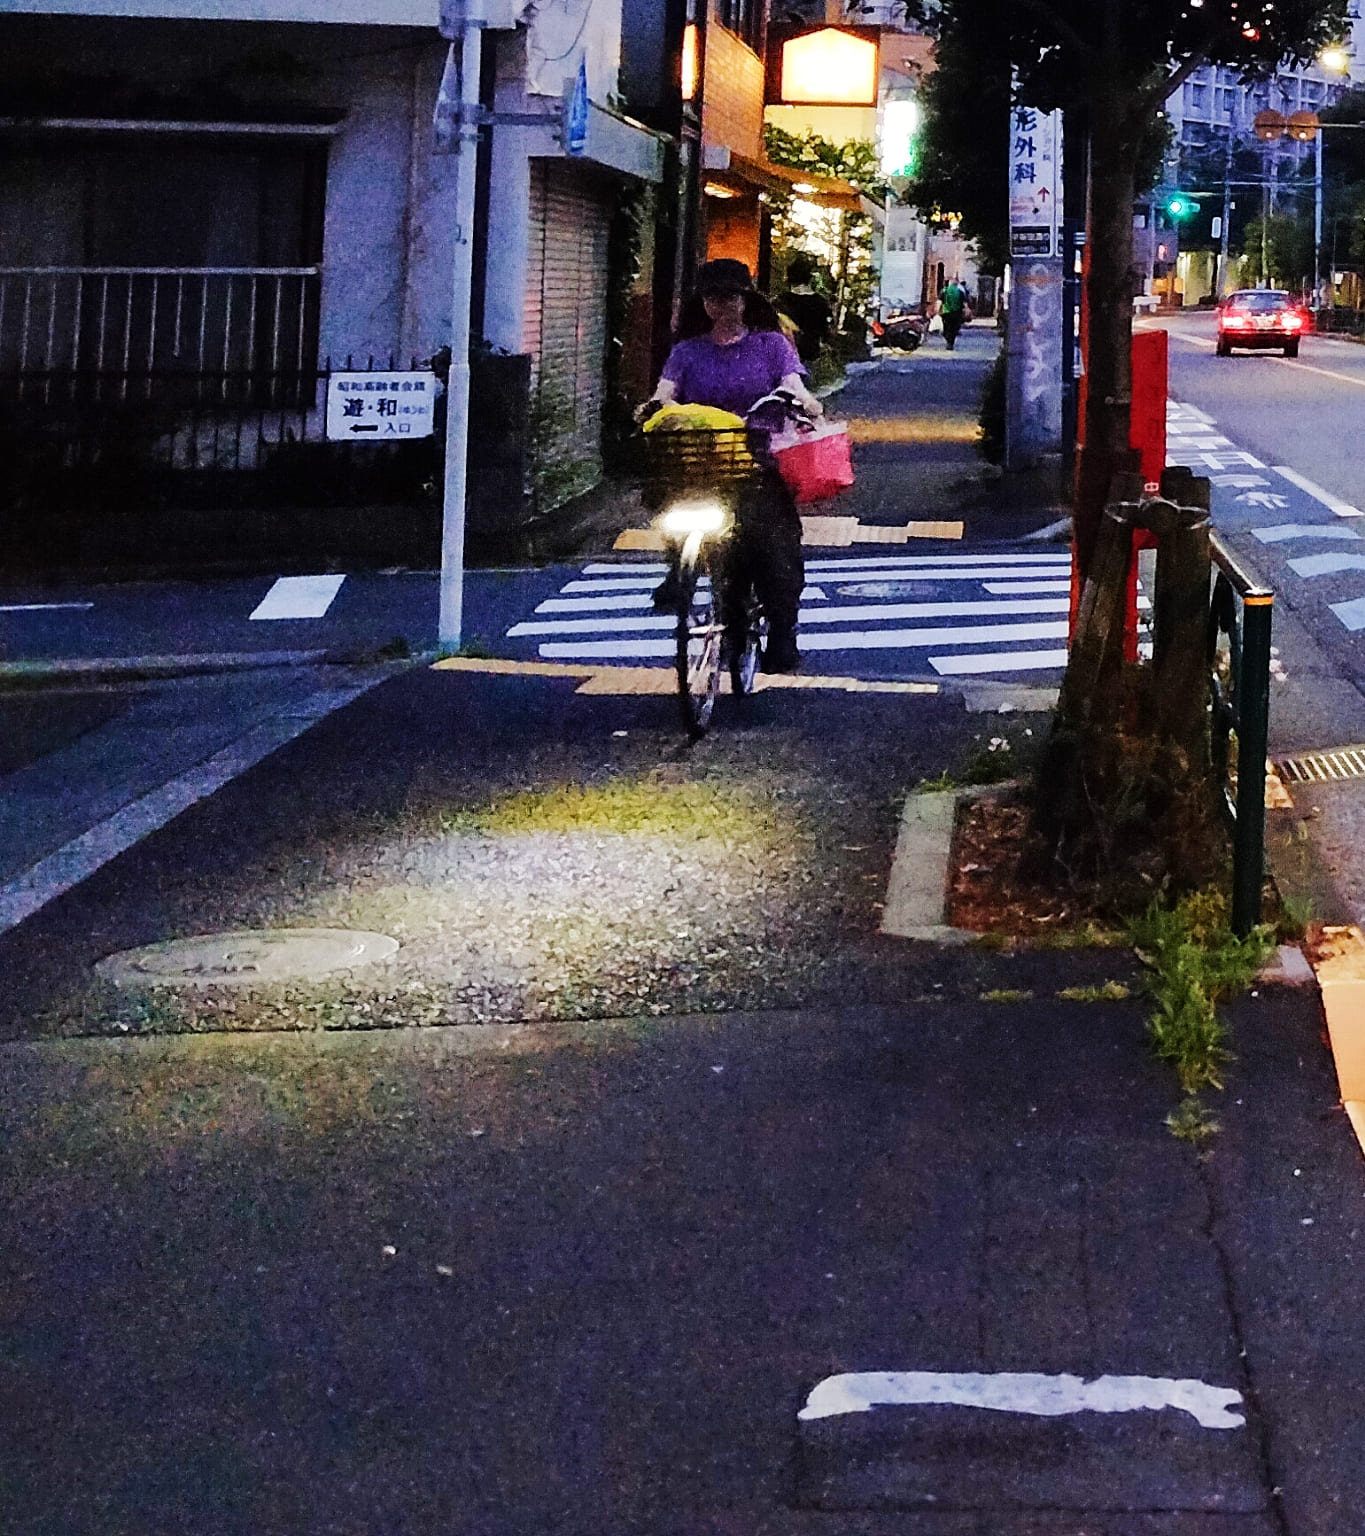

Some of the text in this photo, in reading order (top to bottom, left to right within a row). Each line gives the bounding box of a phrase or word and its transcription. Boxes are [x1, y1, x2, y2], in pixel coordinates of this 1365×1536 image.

[343, 398, 398, 417] 遊・和
[384, 422, 411, 434] 入口
